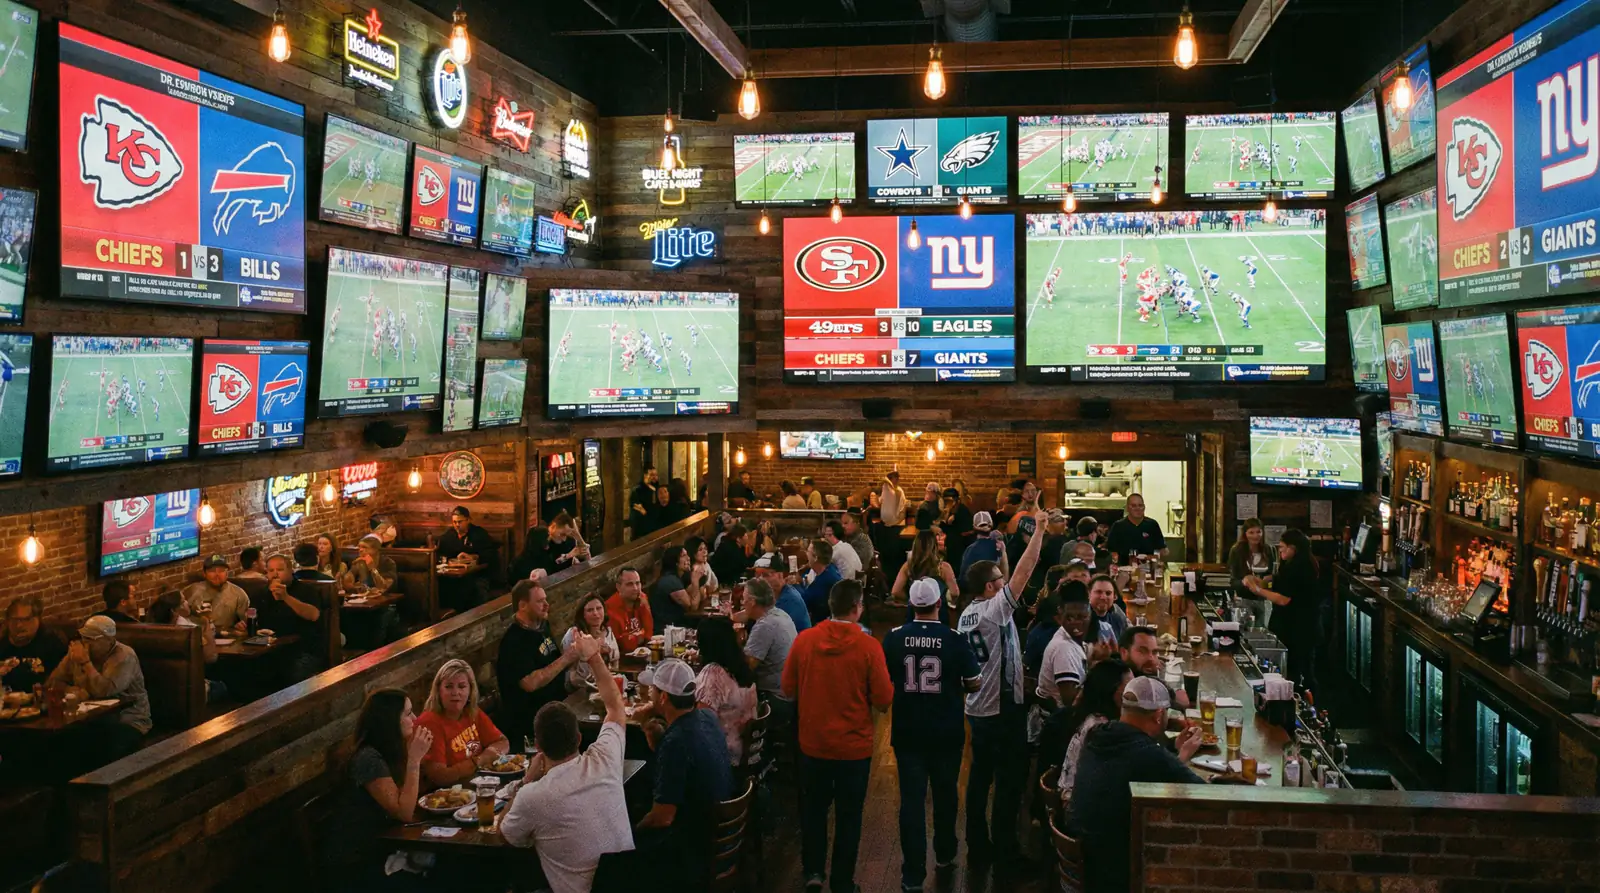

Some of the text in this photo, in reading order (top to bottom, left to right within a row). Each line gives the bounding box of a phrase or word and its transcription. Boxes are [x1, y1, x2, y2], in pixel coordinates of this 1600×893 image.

[348, 30, 395, 70] Heineken
[877, 188, 922, 196] COWBOYS
[957, 186, 992, 195] GIANTS
[652, 228, 714, 267] Lite
[1453, 242, 1491, 270] CHIEFS
[1500, 240, 1507, 260] 2
[1522, 234, 1530, 255] 3
[1541, 219, 1597, 254] GIANTS
[95, 239, 281, 281] CHIEFS 1 VS 3 BILLS
[907, 321, 920, 332] 10
[932, 320, 993, 333] EAGLES
[814, 353, 865, 365] CHIEFS
[881, 354, 887, 364] 1
[909, 354, 917, 365] 7
[934, 352, 988, 365] GIANTS
[212, 426, 241, 439] CHIEFS
[272, 422, 293, 434] BILLS
[1534, 417, 1559, 433] CHIEFS
[904, 636, 942, 649] COWBOYS
[903, 654, 942, 694] 12
